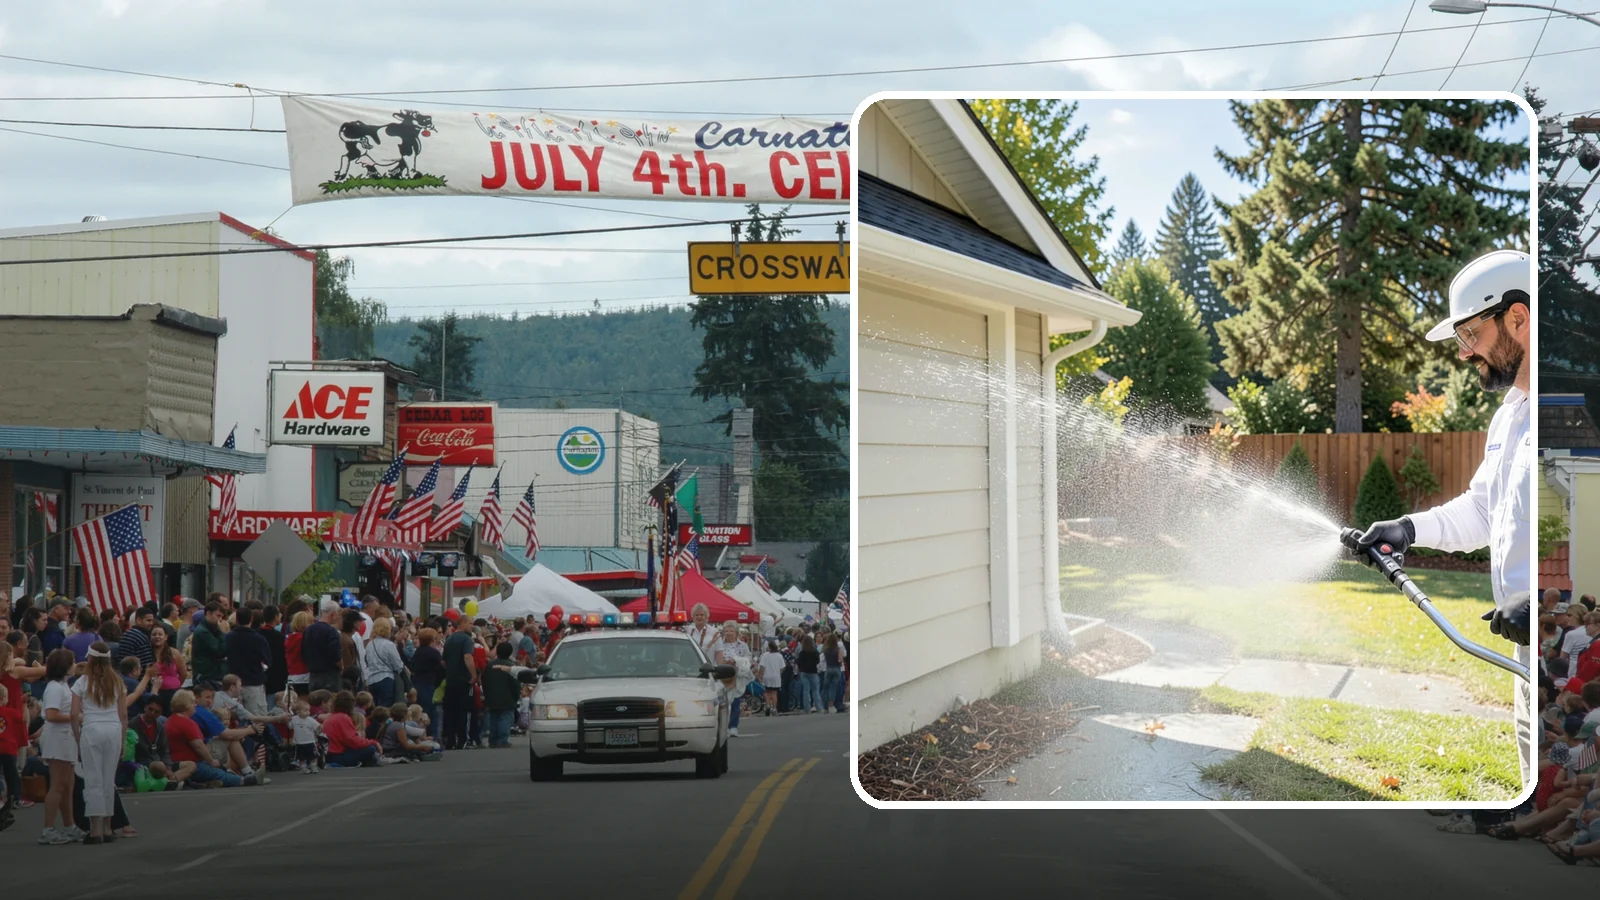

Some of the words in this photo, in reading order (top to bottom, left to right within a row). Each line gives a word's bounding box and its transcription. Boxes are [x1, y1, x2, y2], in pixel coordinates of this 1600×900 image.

[695, 121, 850, 150] Carnat
[481, 141, 605, 192] JULY
[632, 150, 746, 198] 4th.
[697, 254, 850, 280] CROSSWA
[282, 380, 374, 420] ACE
[406, 409, 453, 422] CEDAR
[461, 409, 485, 422] LOG
[283, 421, 371, 437] Hardware
[416, 428, 476, 446] Coca-Cola
[353, 467, 384, 480] Simpl
[96, 485, 125, 494] Vincent
[126, 486, 135, 494] de
[138, 486, 155, 495] Paul
[688, 526, 741, 535] CRNATION
[699, 535, 730, 543] GLASS
